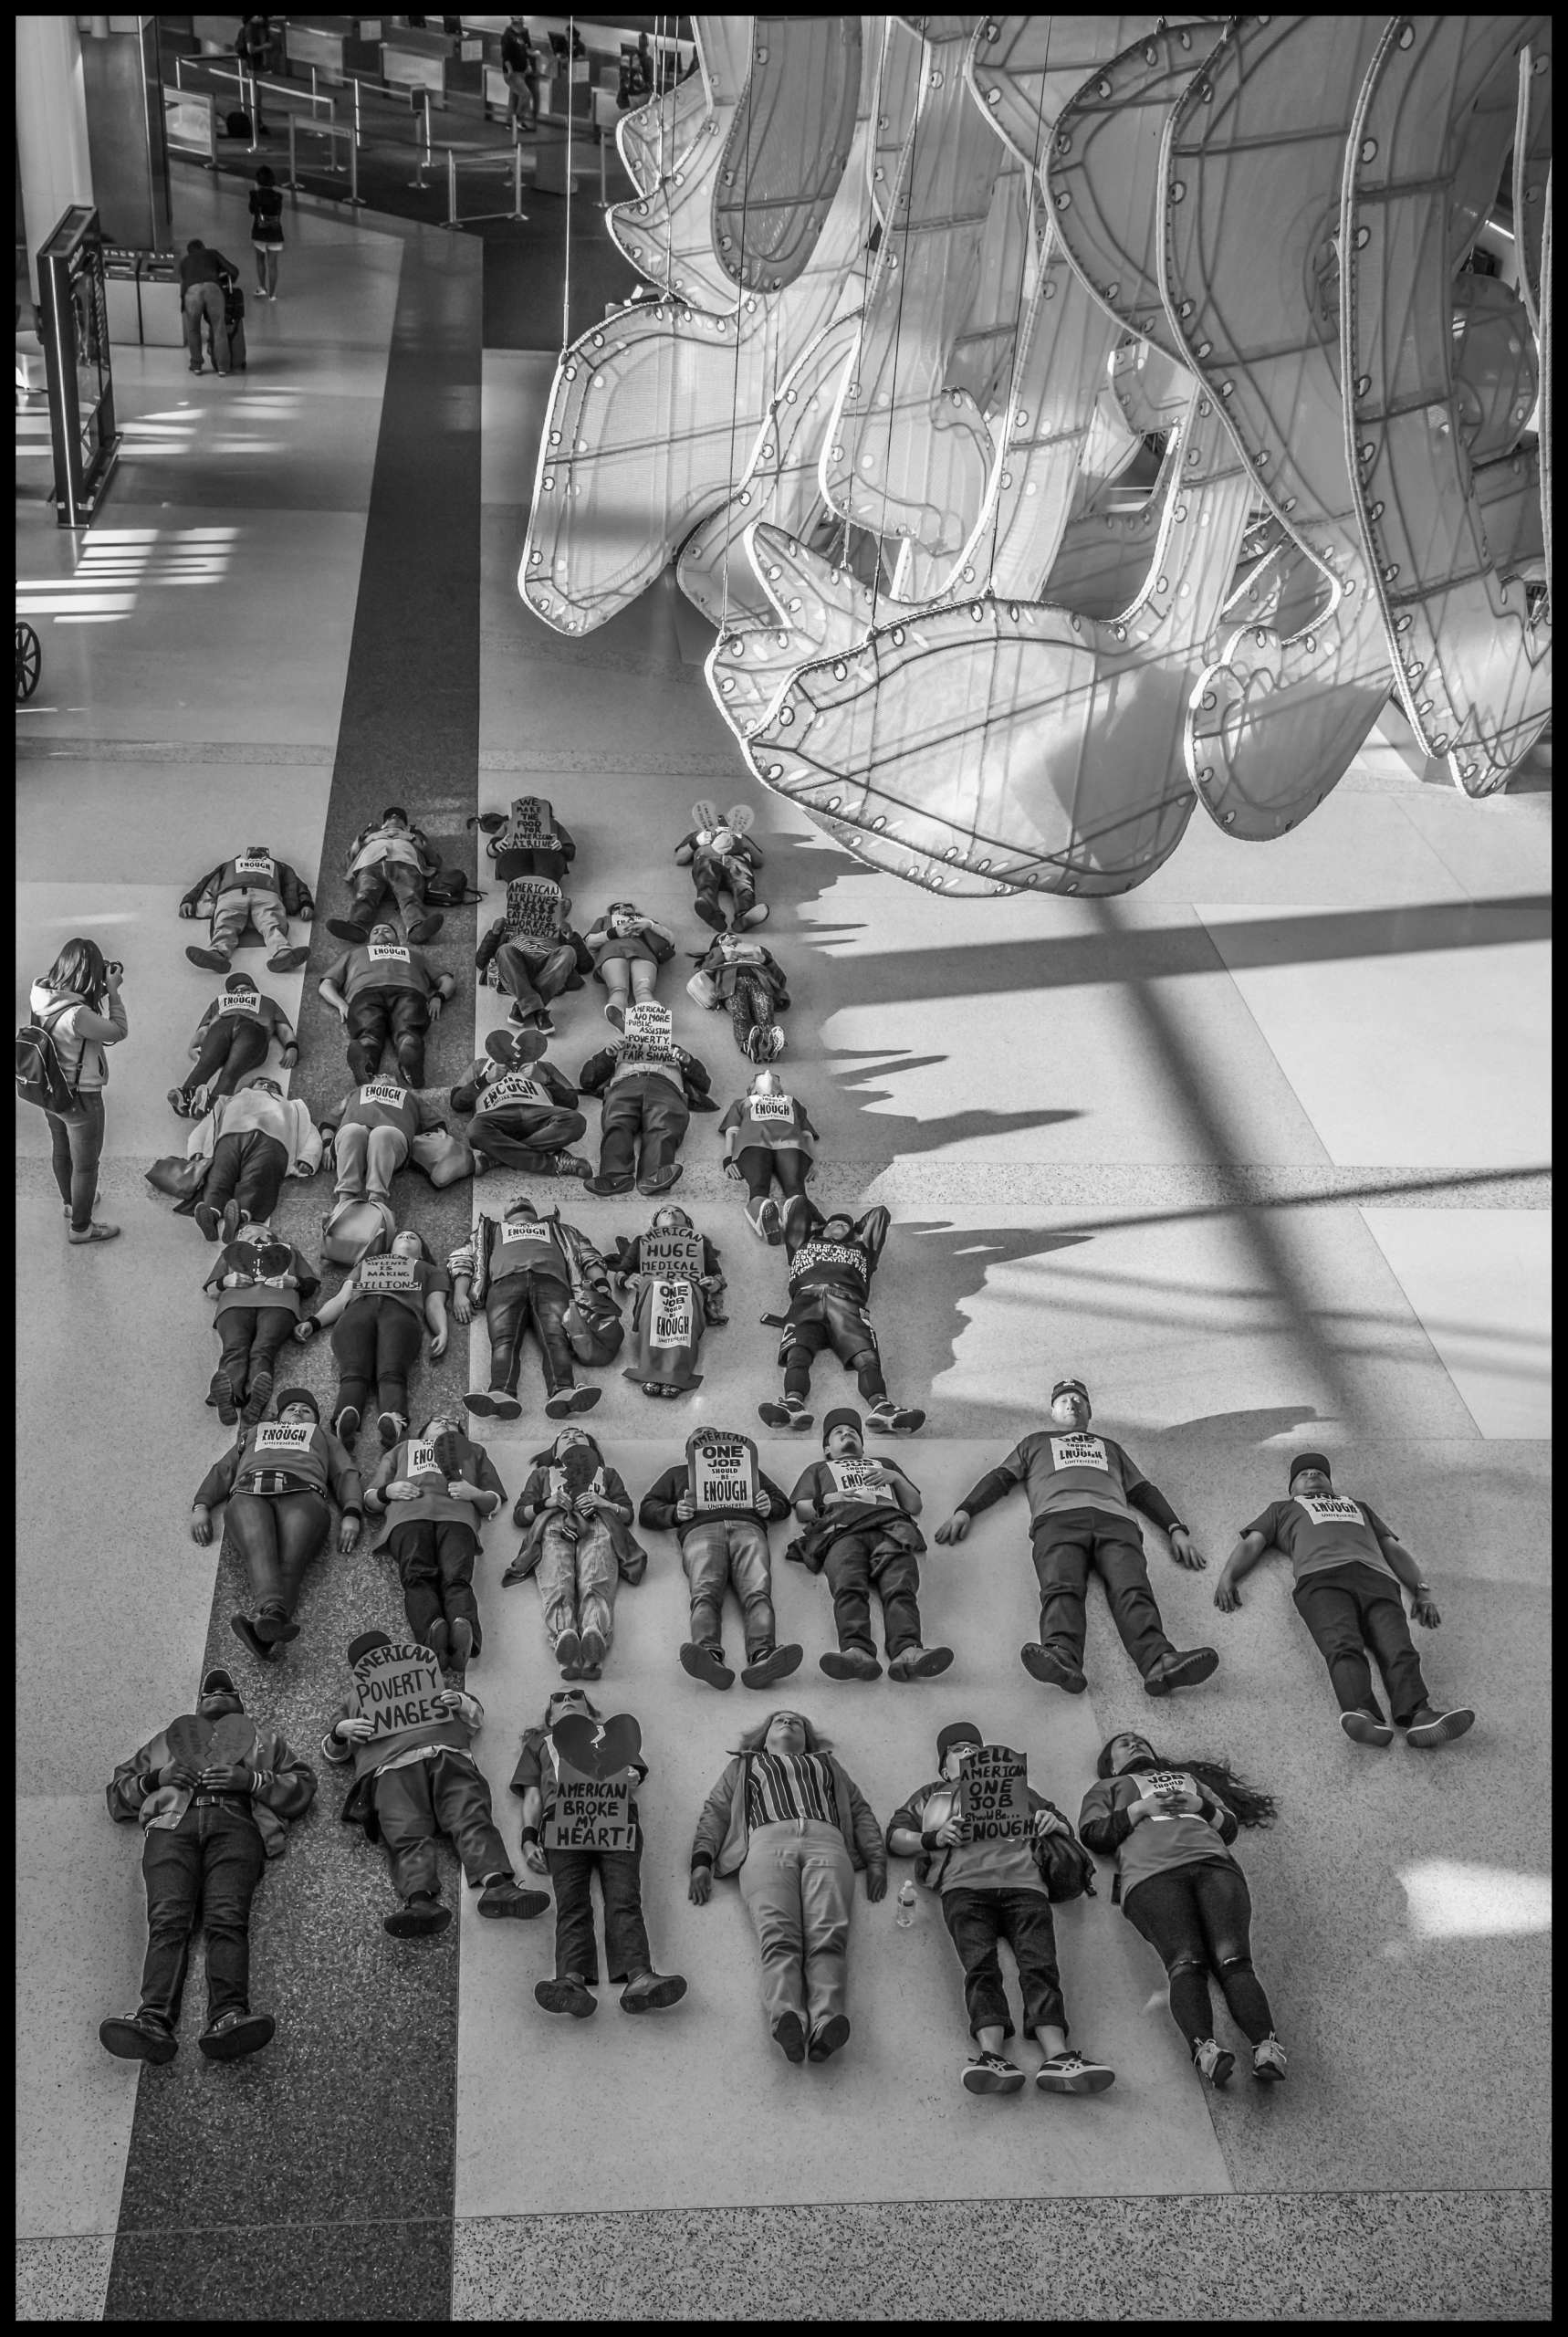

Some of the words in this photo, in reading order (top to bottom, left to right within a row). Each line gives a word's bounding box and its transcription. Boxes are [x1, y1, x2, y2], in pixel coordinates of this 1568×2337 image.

[518, 797, 539, 806] WE
[517, 820, 541, 828] FOOD
[524, 826, 541, 834] FOR
[240, 862, 271, 871] ENOUGH
[508, 882, 559, 895] AMERICAN
[507, 894, 559, 905] AIRLINES
[507, 911, 553, 922] CATERING
[507, 918, 557, 929] WORKERS
[517, 927, 559, 938] POVERTY
[374, 948, 406, 956] ENOUGH
[224, 996, 256, 1007] ENOUGH
[632, 1005, 667, 1015] AMERICAN
[634, 1012, 647, 1021] NO
[649, 1014, 671, 1023] MORE
[622, 1051, 644, 1061] FAIR
[646, 1052, 675, 1063] SHARE
[366, 1086, 402, 1101] ENOUGH
[483, 1078, 539, 1110] ENOUGH
[755, 1104, 789, 1116] ENOUGH
[642, 1227, 703, 1245] AMERICAN
[647, 1243, 698, 1258] HUGE
[642, 1261, 698, 1272] MEDICAL
[352, 1281, 423, 1289] BILLIONS!
[660, 1286, 688, 1298] ONE
[663, 1297, 685, 1306] JOB
[657, 1316, 689, 1336] ENOUGH
[263, 1429, 307, 1442] ENOUGH
[693, 1431, 748, 1450] AMERICAN
[1058, 1434, 1097, 1444] ONE
[414, 1449, 434, 1465] ENO
[702, 1445, 745, 1459] ONE
[707, 1459, 741, 1468] JOB
[841, 1474, 863, 1490] ENO
[704, 1480, 747, 1502] ENOUGH
[1312, 1503, 1358, 1513] ENOUGH
[354, 1644, 436, 1682] AMERICAN
[357, 1667, 437, 1708] POVERTY
[363, 1695, 450, 1734] WAGES
[967, 1747, 1013, 1768] TELL
[961, 1766, 1027, 1781] AMERICAN
[1147, 1774, 1186, 1784] JOB
[558, 1782, 627, 1799] AMERICAN
[969, 1778, 1014, 1797] ONE
[1154, 1780, 1184, 1789] SHOULD
[969, 1794, 1013, 1811] JOB
[563, 1800, 620, 1818] BROKE
[576, 1814, 598, 1829] MY
[557, 1827, 634, 1850] HEART!
